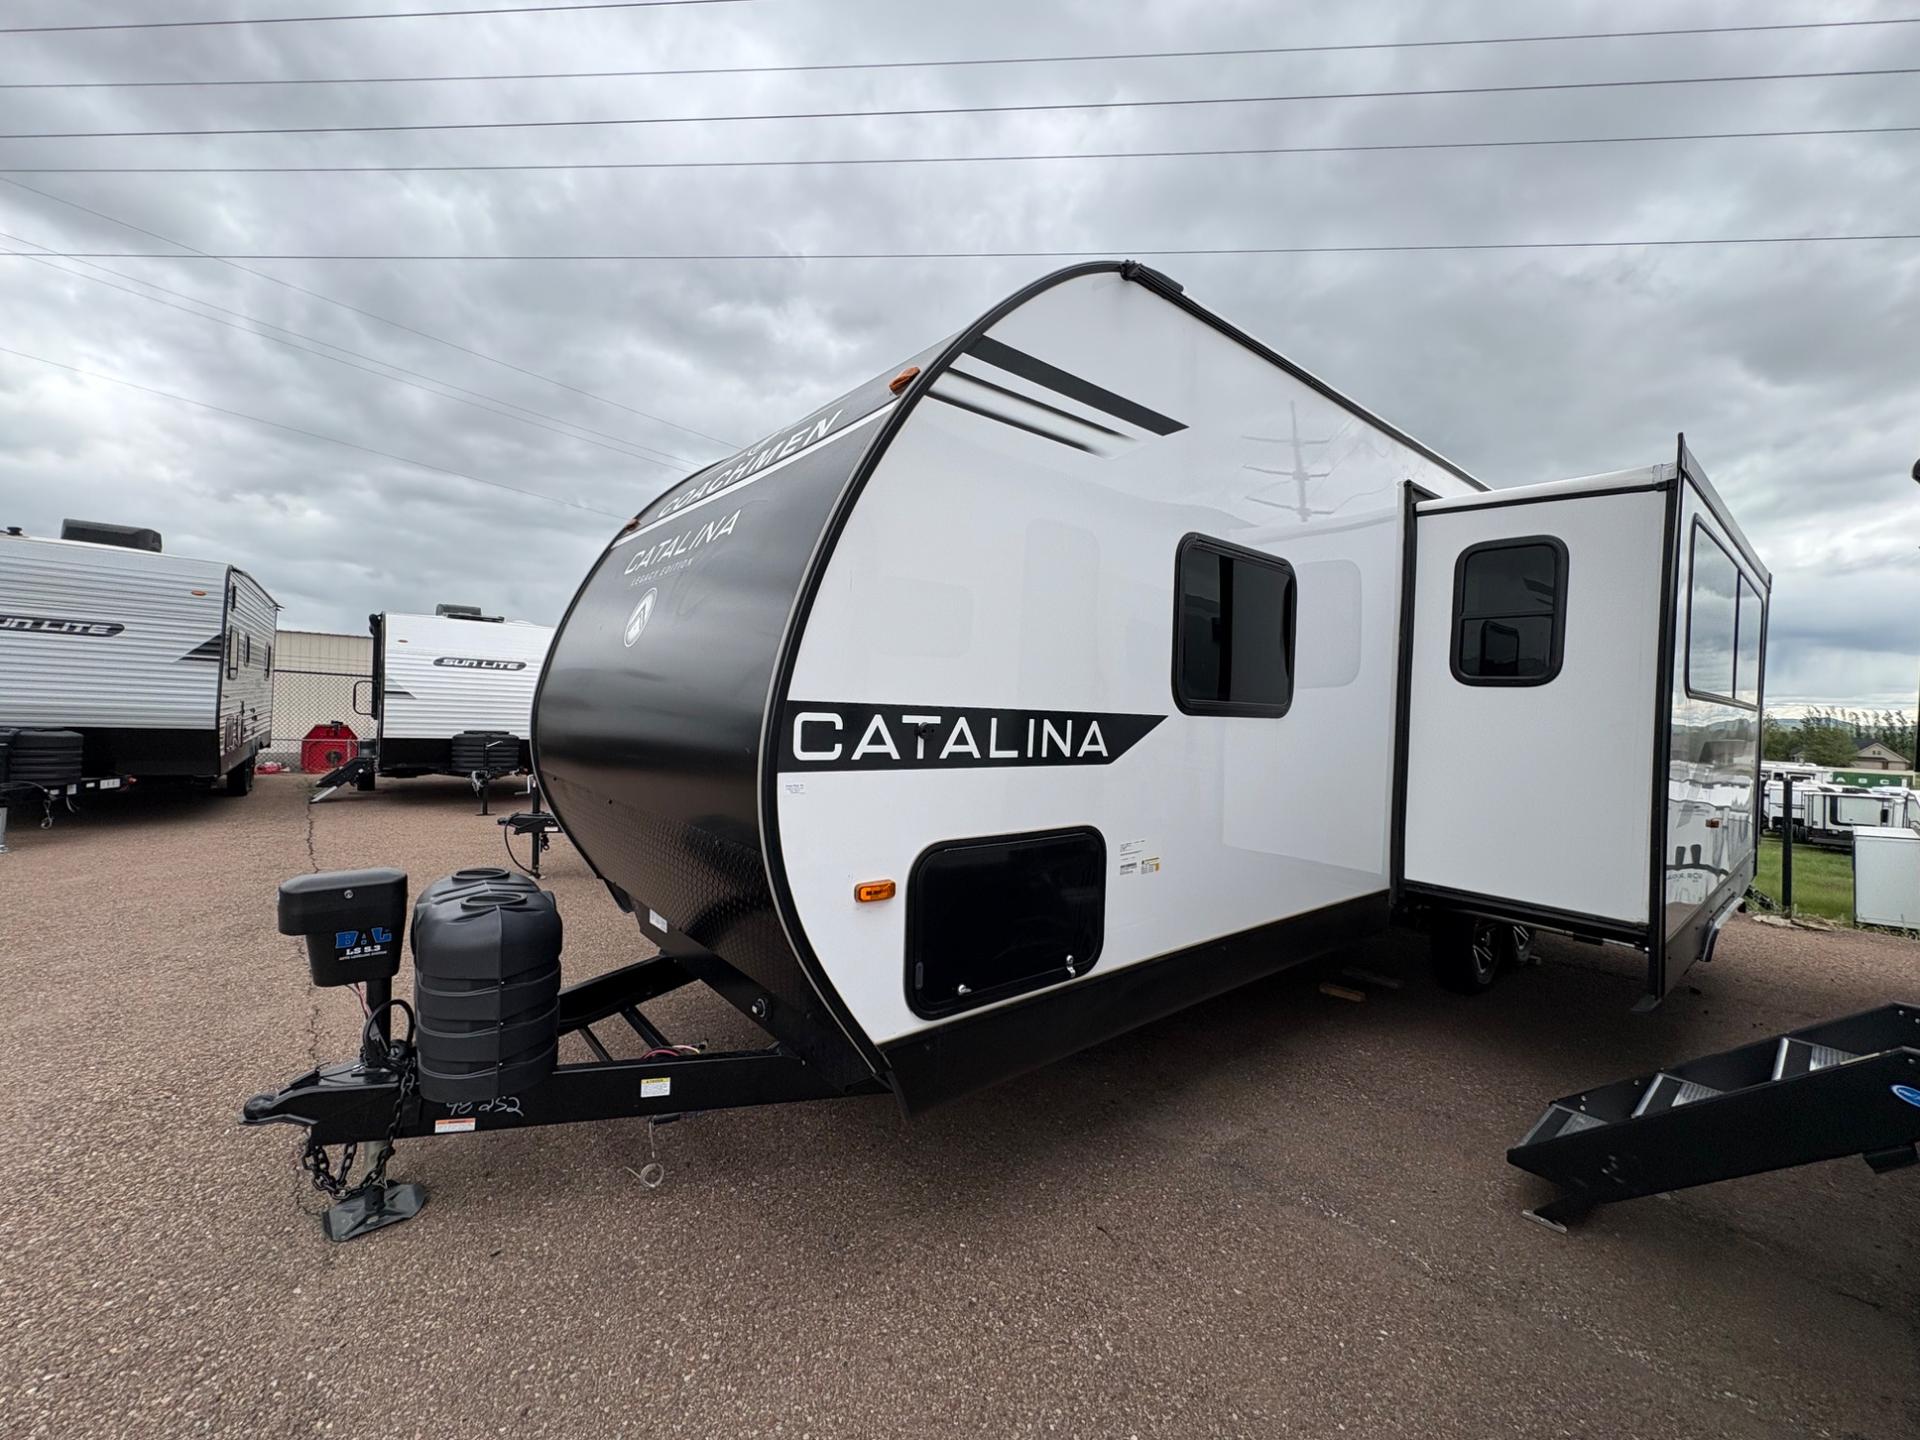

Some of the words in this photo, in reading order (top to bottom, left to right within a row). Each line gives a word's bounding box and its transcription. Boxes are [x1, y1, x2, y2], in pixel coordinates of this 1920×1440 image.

[657, 408, 843, 519] COACHMEN
[624, 509, 741, 575] CATALINA
[40, 620, 111, 635] LITE
[441, 658, 478, 668] SUN
[481, 661, 520, 670] LITE
[793, 711, 1109, 762] CATALINA
